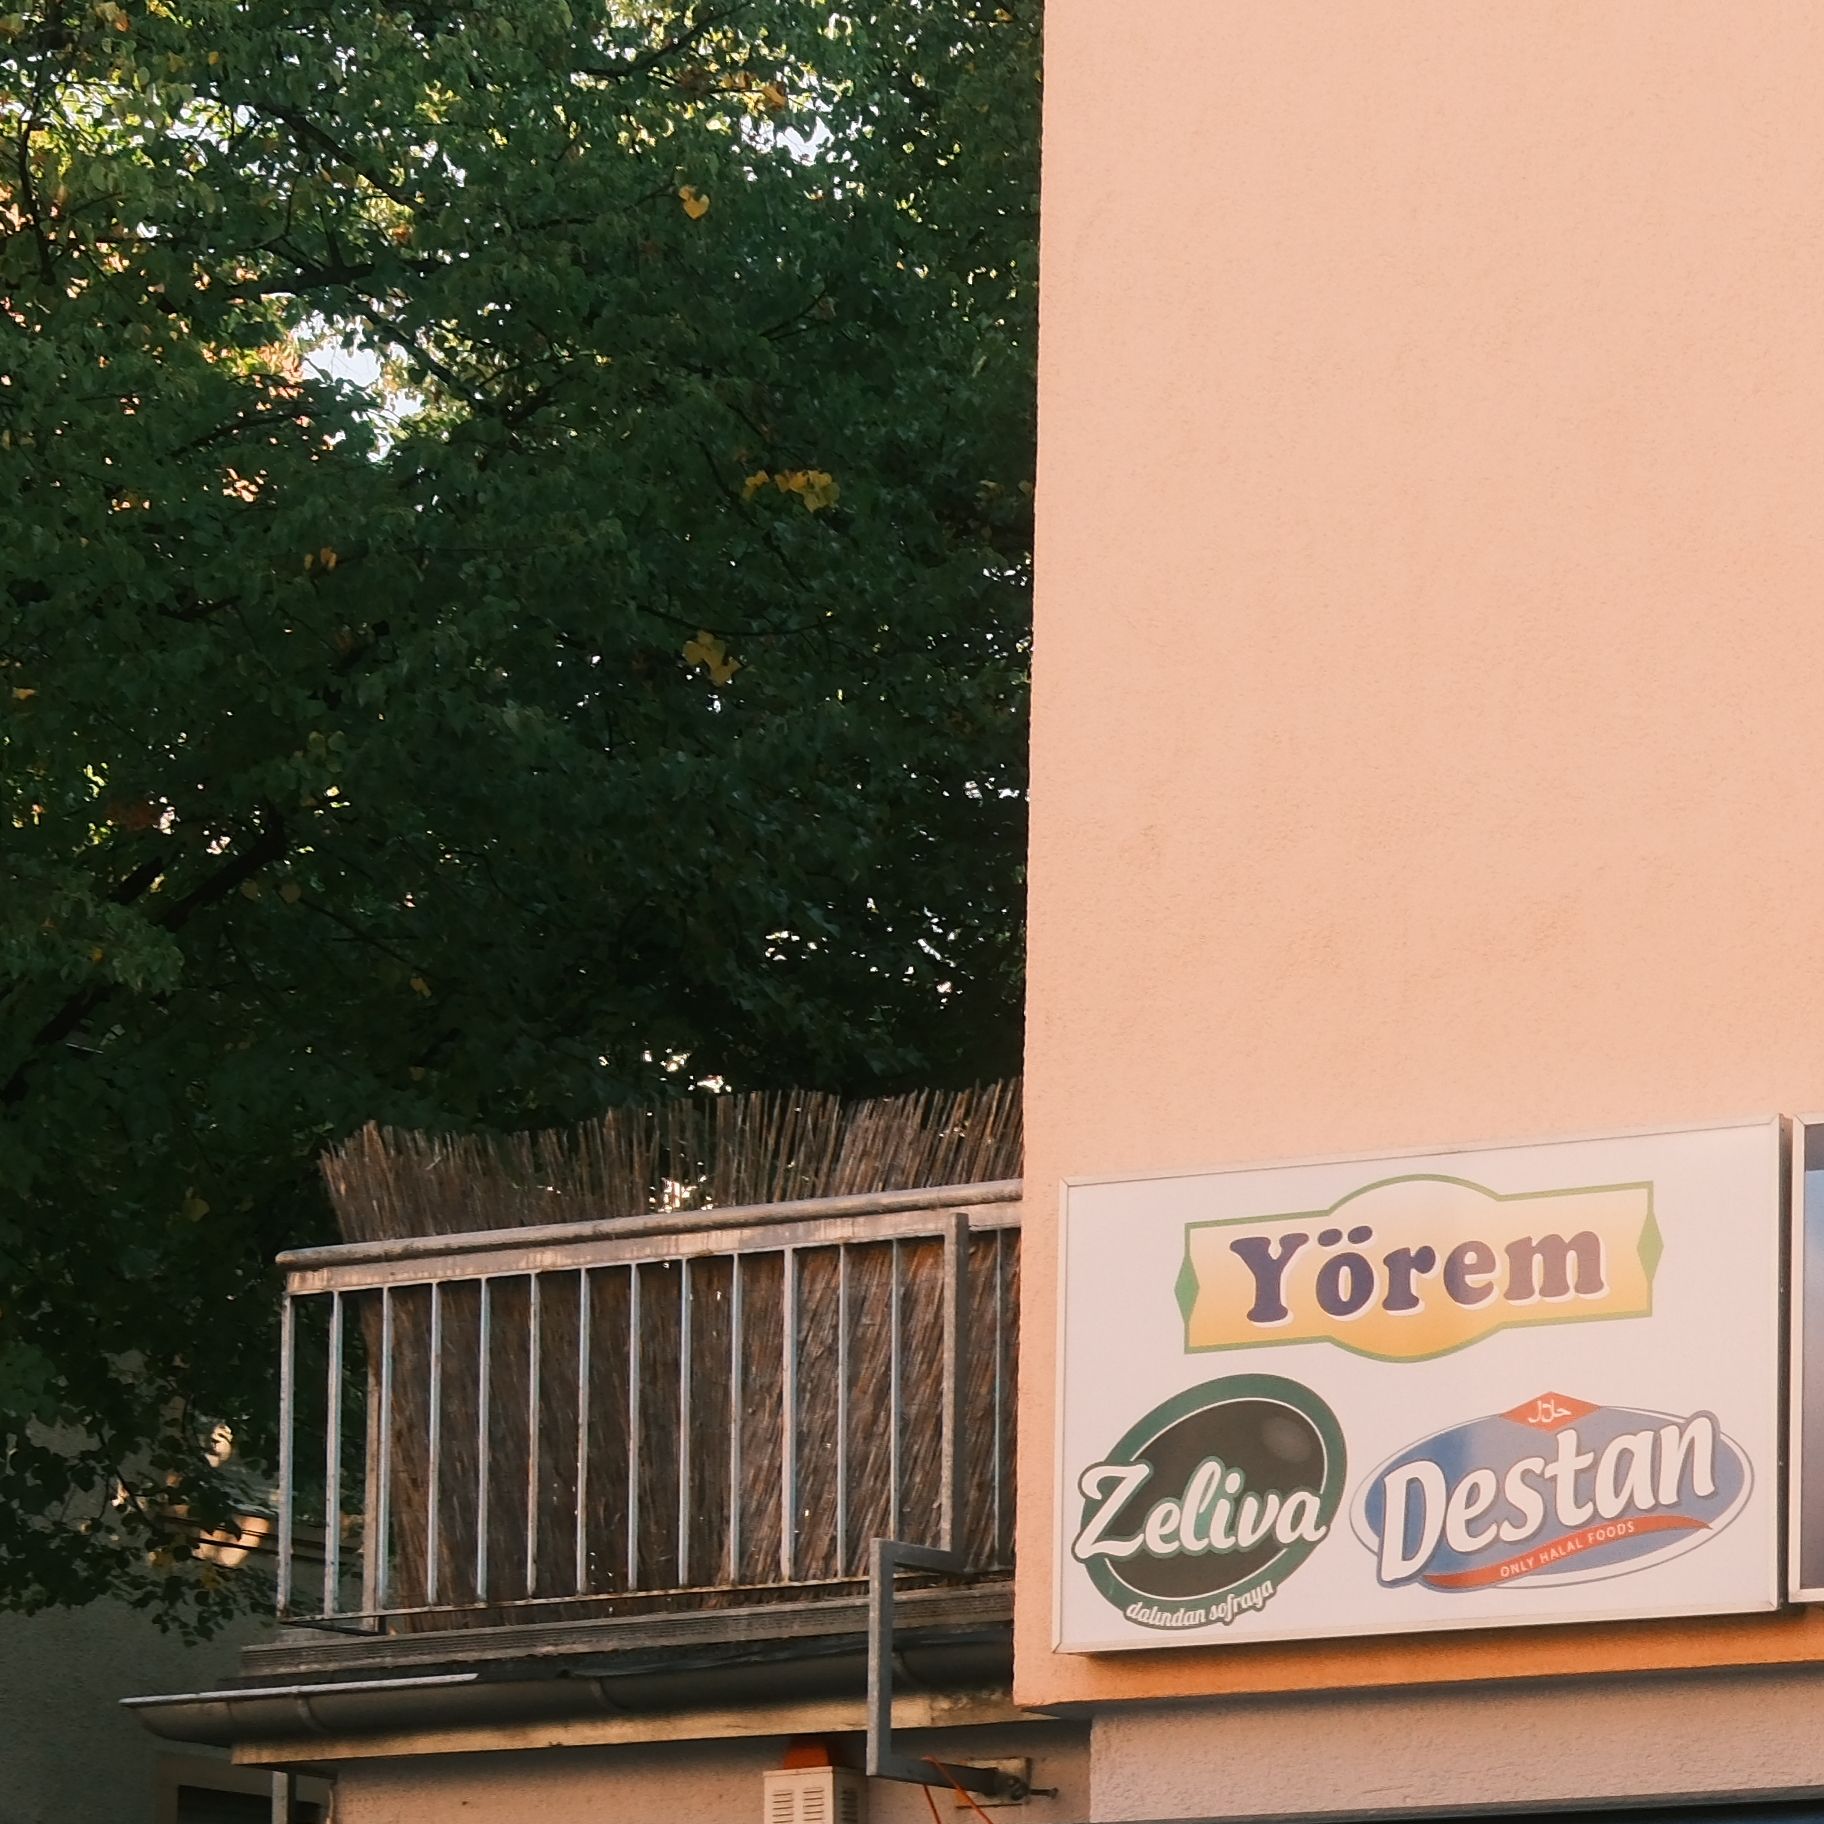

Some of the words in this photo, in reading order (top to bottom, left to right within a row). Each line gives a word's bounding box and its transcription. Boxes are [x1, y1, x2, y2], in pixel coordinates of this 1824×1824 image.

[1230, 1225, 1608, 1326] Yörem
[1074, 1456, 1331, 1561] Zeliva
[1379, 1413, 1719, 1586] Destan
[1499, 1557, 1535, 1578] ONLY
[1539, 1538, 1583, 1564] HALAL
[1587, 1519, 1636, 1545] FOODS
[1208, 1580, 1274, 1622] sofraya
